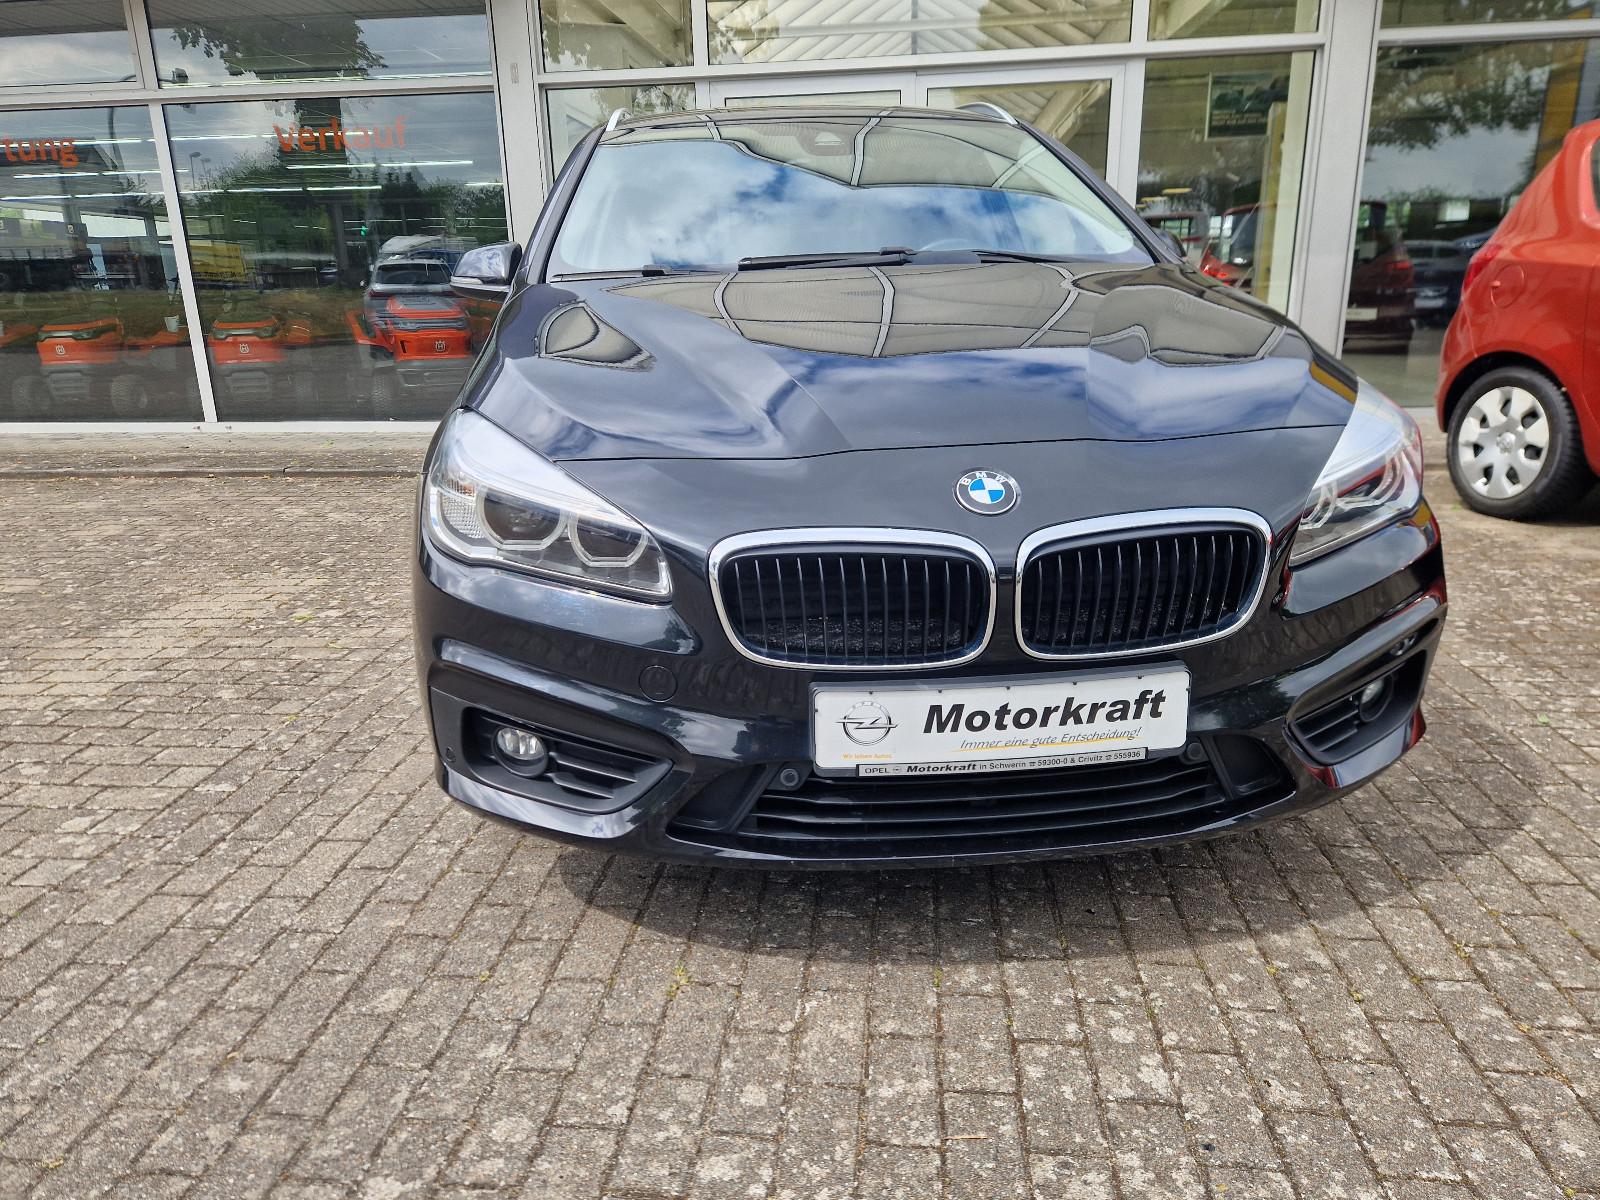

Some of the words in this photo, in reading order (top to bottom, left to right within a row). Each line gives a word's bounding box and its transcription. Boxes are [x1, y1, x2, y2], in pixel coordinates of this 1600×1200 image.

[960, 470, 1008, 486] BMW
[923, 688, 1167, 734] Motorkraft
[960, 739, 1002, 749] Immer
[1004, 737, 1027, 747] eine
[1030, 736, 1058, 749] gute
[1061, 727, 1142, 743] Entscheidung!
[906, 763, 977, 773] Motorkraft
[989, 761, 1026, 770] Schwerin
[1078, 754, 1103, 764] Crivitz
[1113, 750, 1141, 760] 555936
